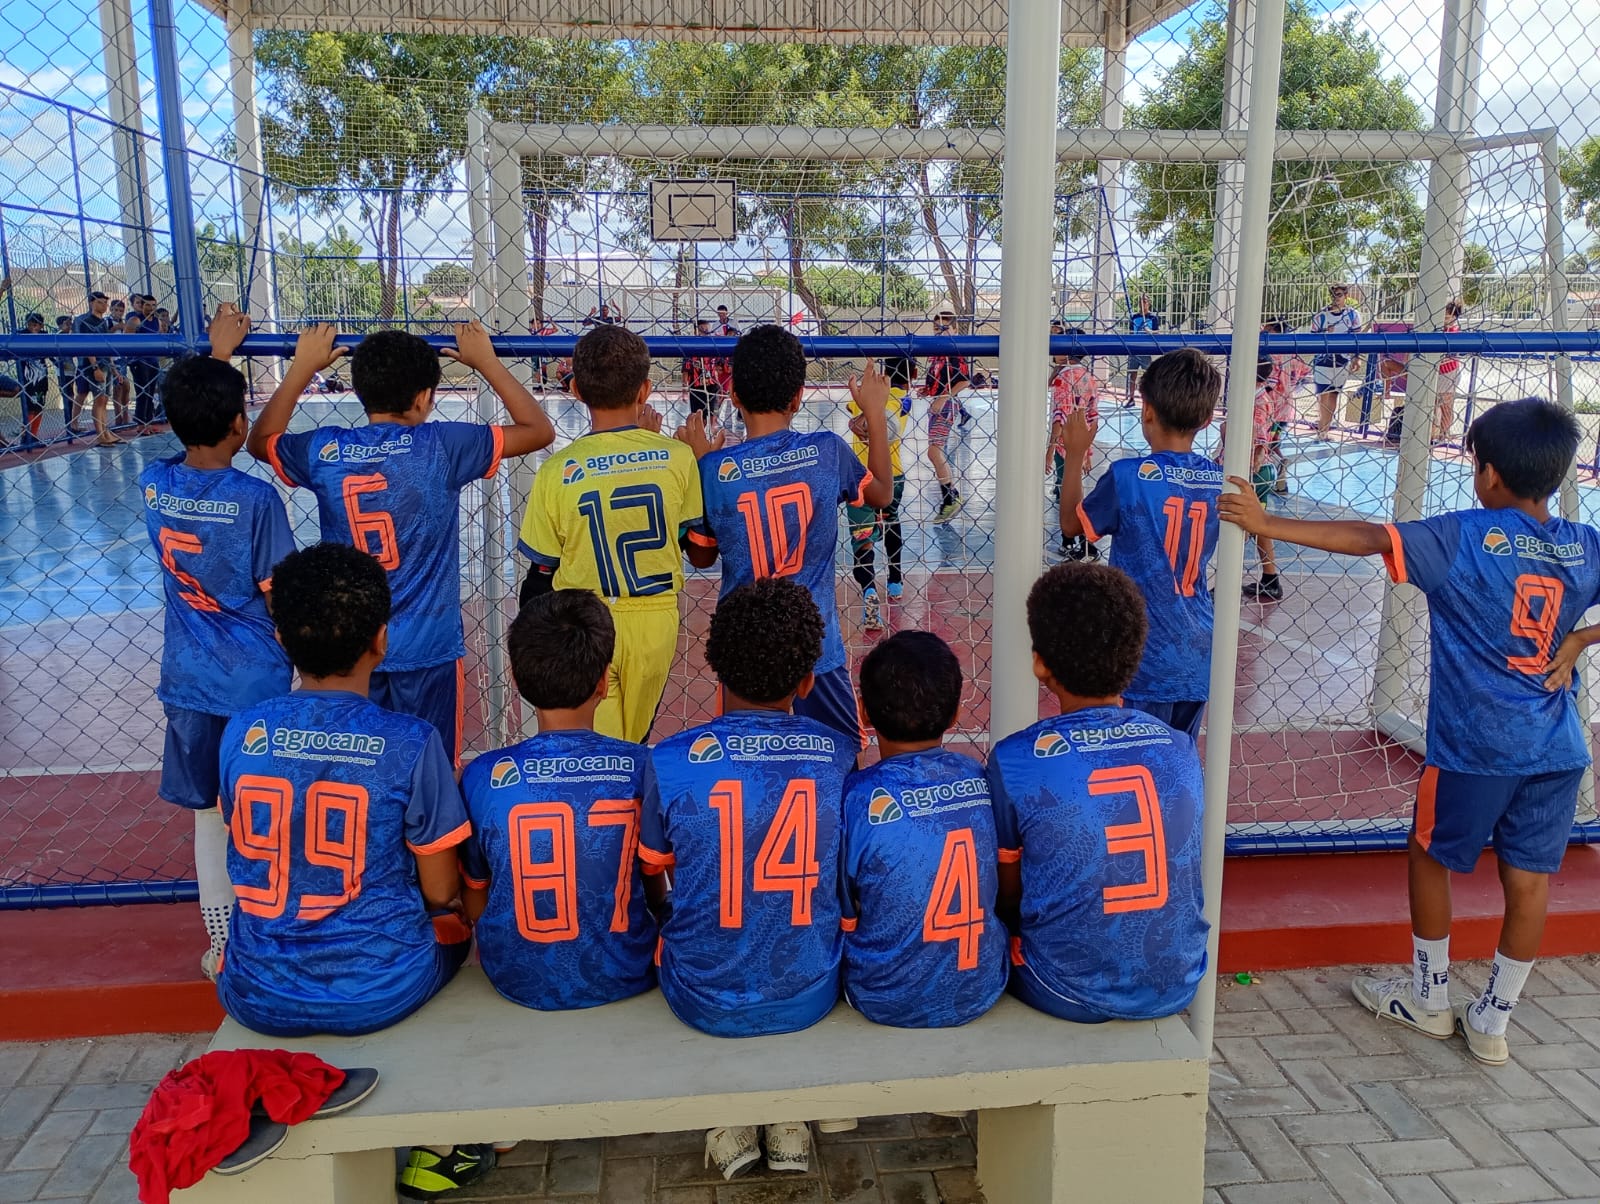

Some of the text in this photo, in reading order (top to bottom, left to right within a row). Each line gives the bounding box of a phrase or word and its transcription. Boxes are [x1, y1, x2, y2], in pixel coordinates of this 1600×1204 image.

[342, 434, 412, 459] agrocaa
[586, 449, 670, 471] agrocana
[742, 445, 819, 472] agrocana
[1165, 465, 1224, 481] agocana
[159, 493, 239, 516] agrocana
[342, 472, 399, 571] 6
[578, 483, 673, 597] 12
[736, 482, 813, 580] 10
[1163, 496, 1208, 597] 11
[158, 526, 221, 613] 5
[1507, 573, 1565, 675] 9
[272, 727, 385, 755] agrocana
[523, 755, 635, 777] agrocana
[726, 734, 835, 755] agrocana
[1069, 722, 1170, 746] agrocana
[901, 778, 990, 809] agrocana
[231, 774, 369, 921] 99
[508, 799, 641, 943] 87
[709, 778, 820, 928] 14
[1087, 764, 1169, 914] 3
[923, 828, 984, 971] 4
